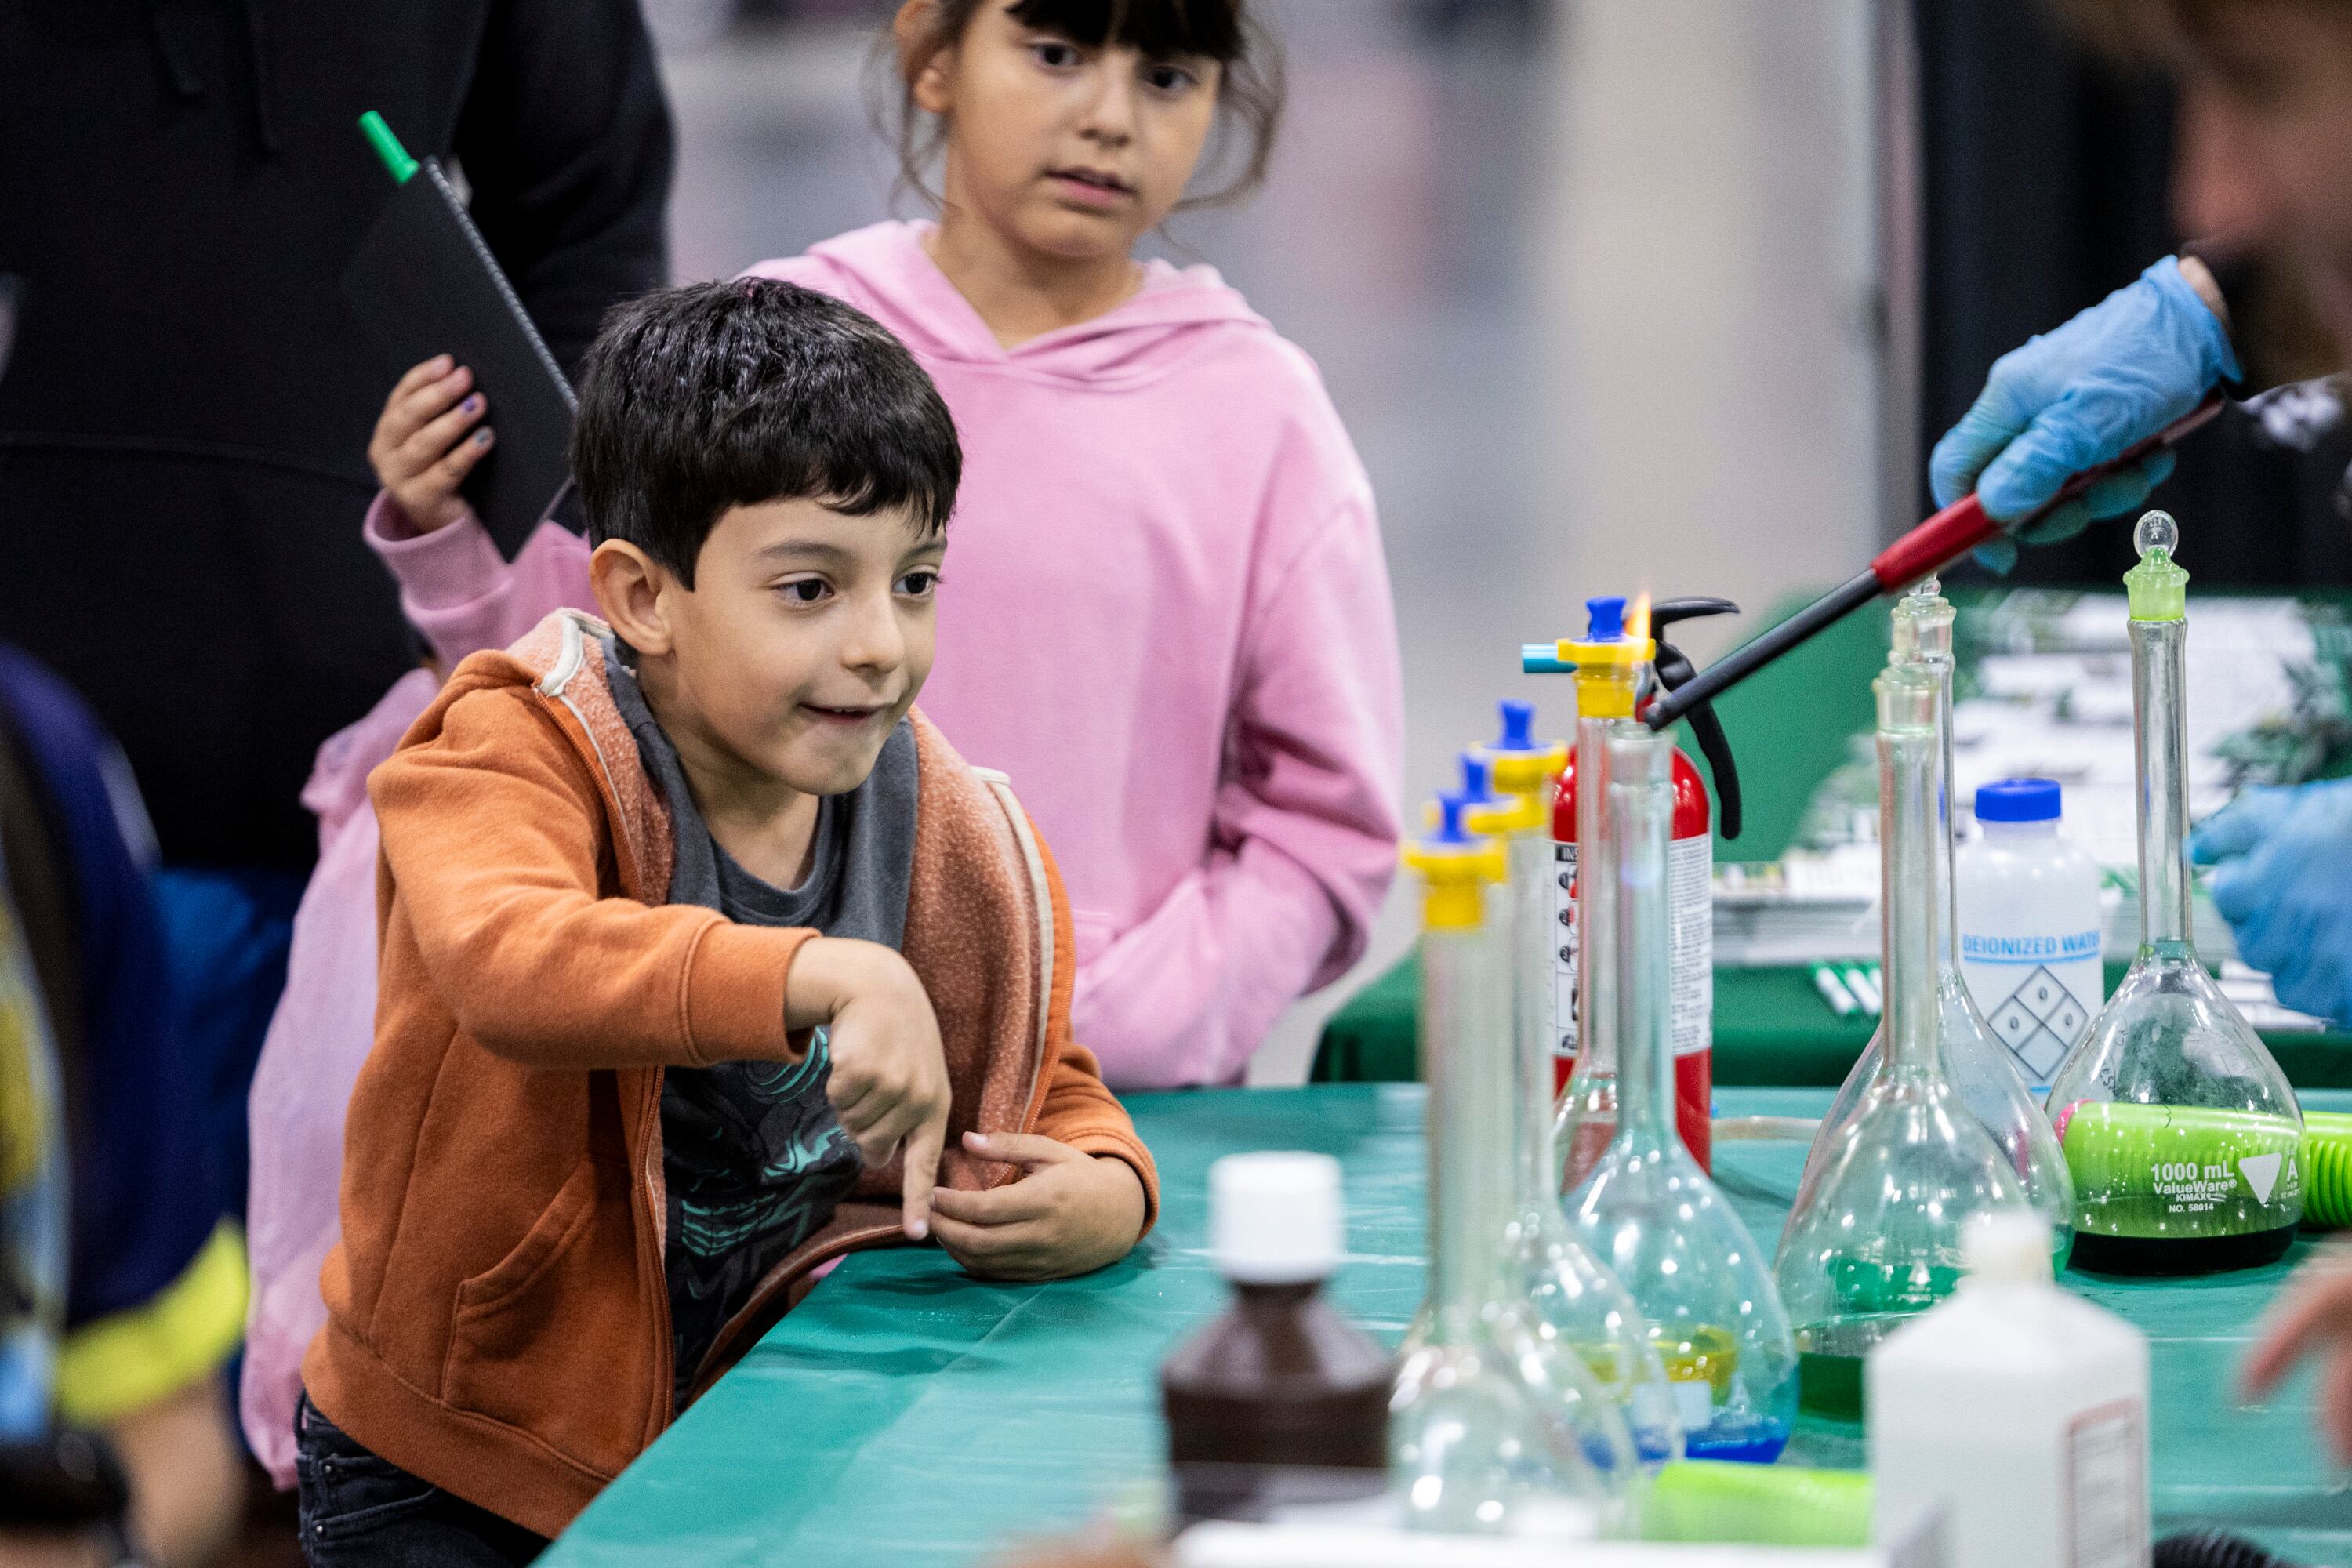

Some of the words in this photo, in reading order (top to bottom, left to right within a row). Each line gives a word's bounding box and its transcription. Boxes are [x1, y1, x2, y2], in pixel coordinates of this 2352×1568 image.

[1963, 934, 2056, 955] DEIONIZED
[2151, 1162, 2198, 1181] 1000
[2204, 1160, 2234, 1179] mL
[2287, 1157, 2299, 1181] A
[2153, 1178, 2238, 1195] ValueWare®
[2169, 1204, 2186, 1213] NO.
[2188, 1202, 2214, 1212] 58014
